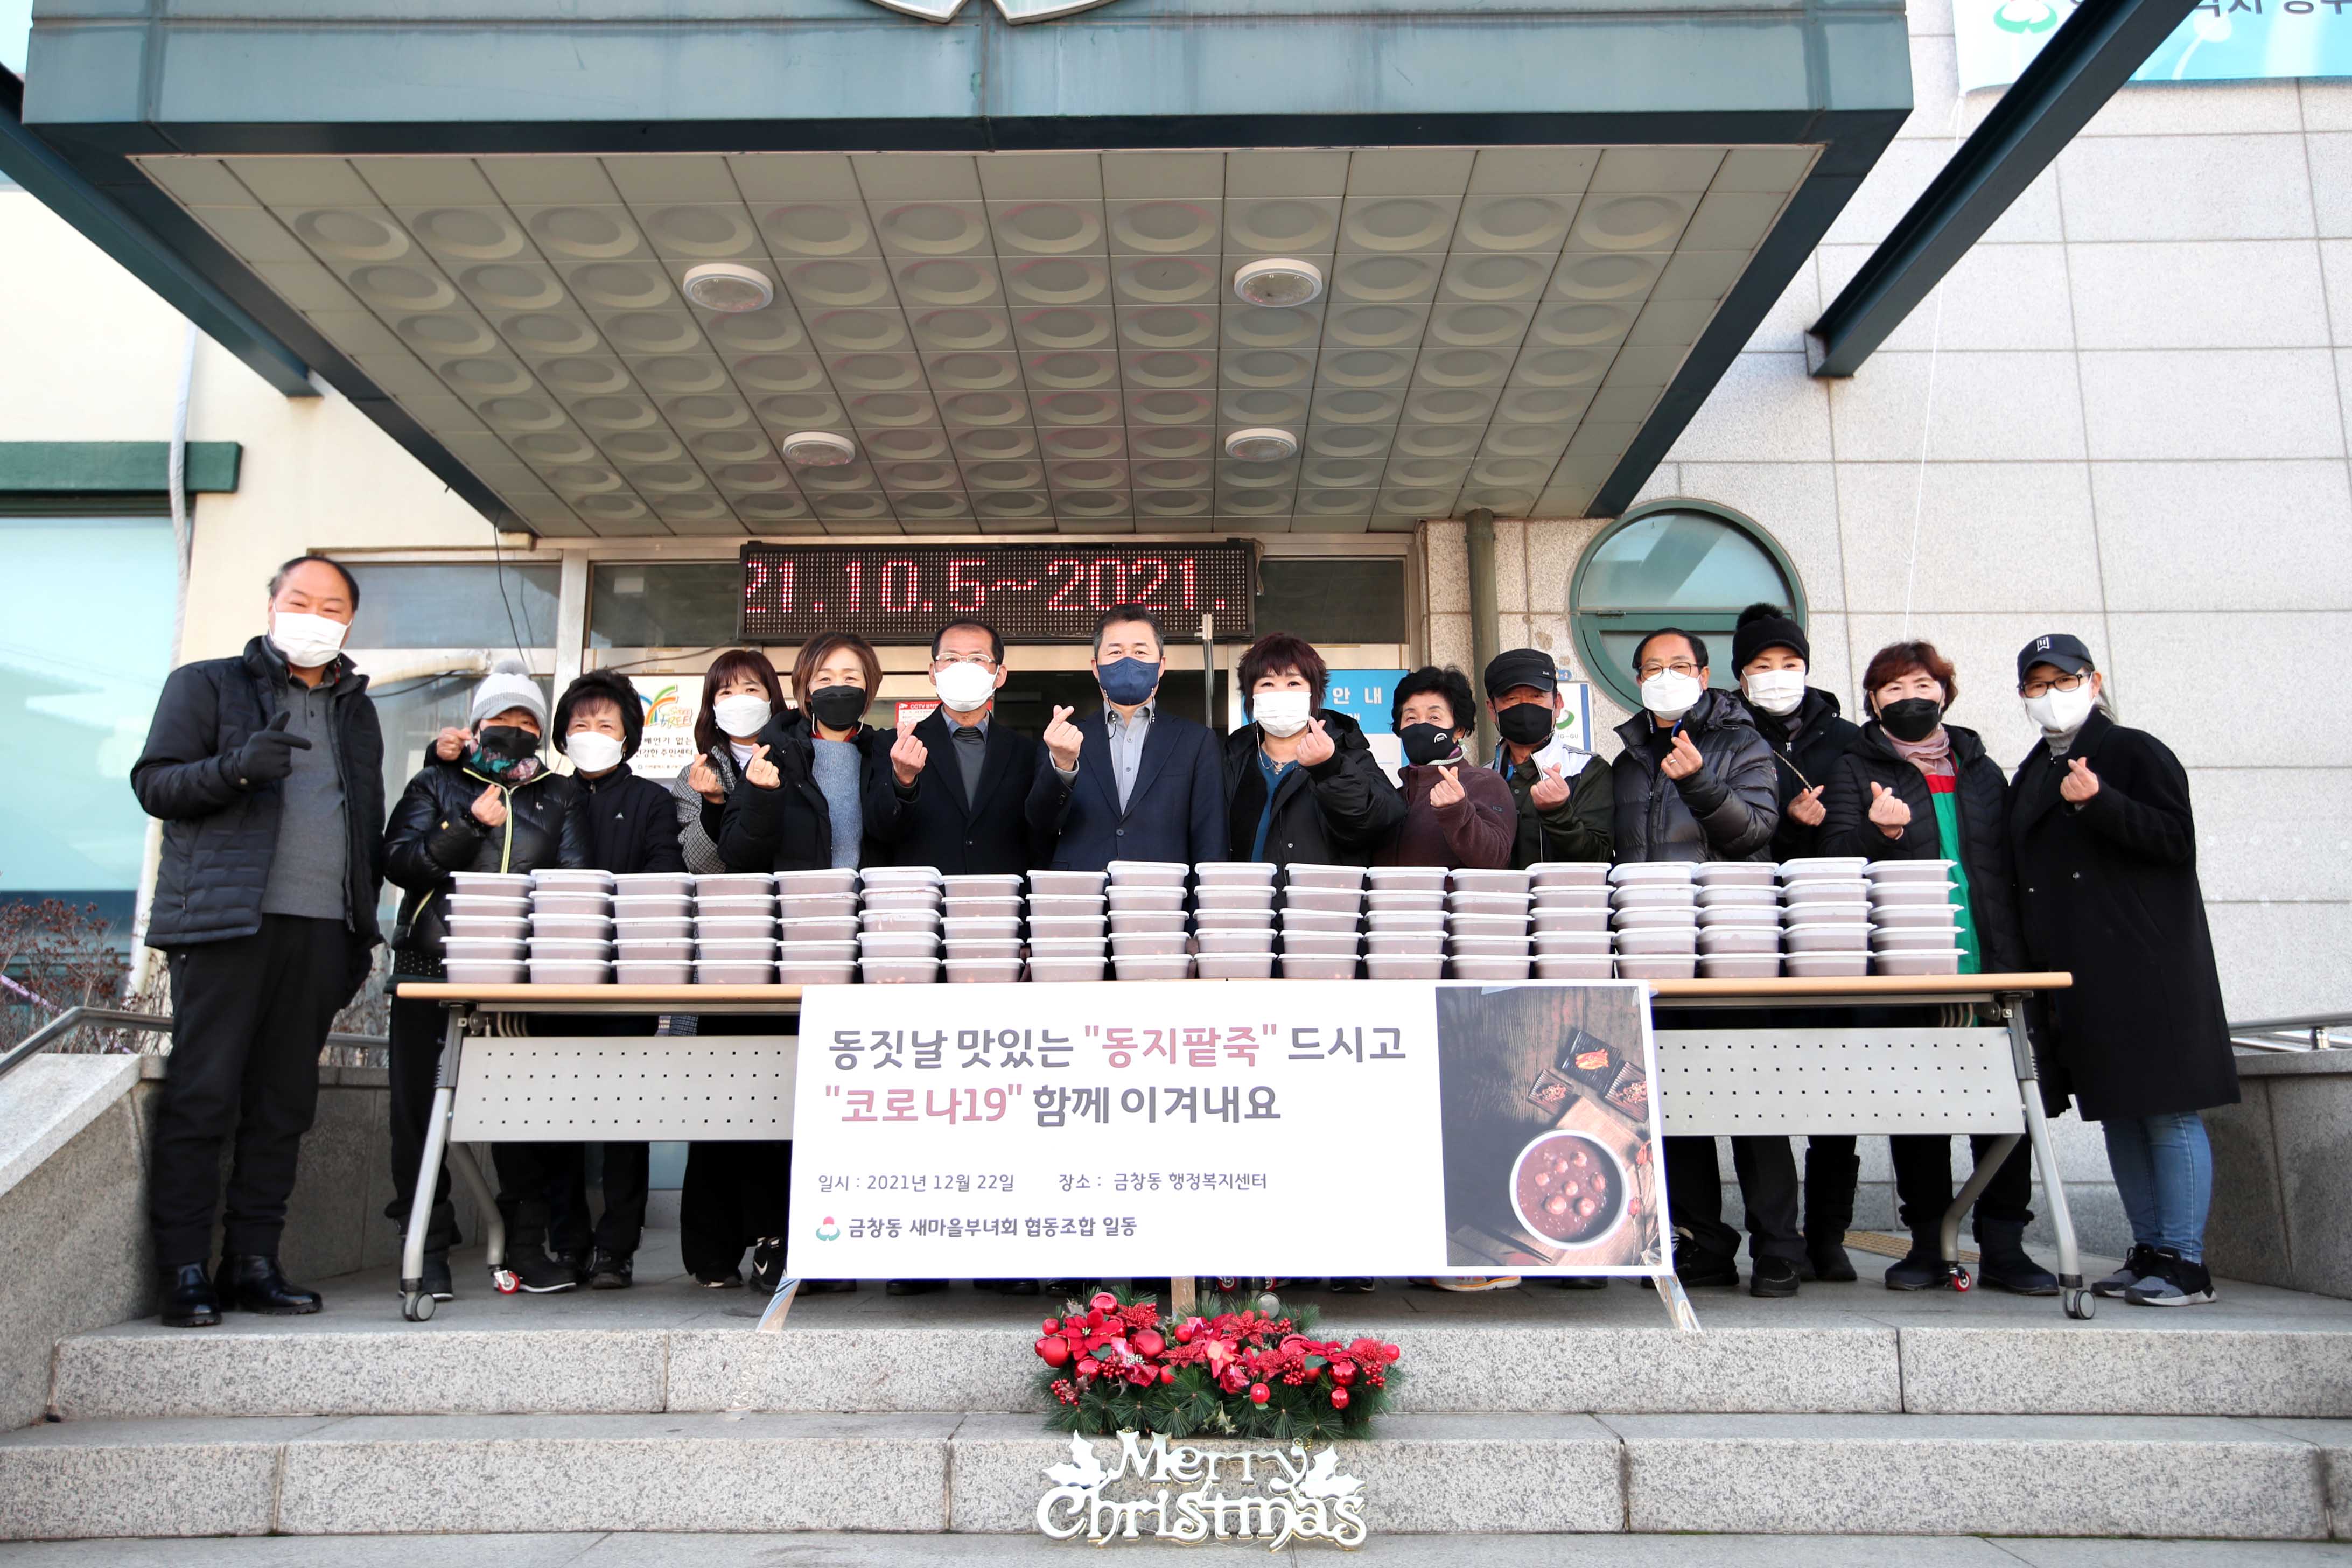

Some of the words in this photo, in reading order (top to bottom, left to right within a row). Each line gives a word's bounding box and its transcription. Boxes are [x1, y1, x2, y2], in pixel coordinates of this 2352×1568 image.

[644, 737, 670, 746] 배연기
[676, 737, 692, 746] 없는
[661, 748, 693, 758] 주민센터
[829, 1030, 948, 1070] 동짓날
[958, 1029, 1074, 1068] 맛있는
[1085, 1024, 1276, 1068] "동지팥죽"
[1288, 1027, 1406, 1063] 드시고
[826, 1084, 1022, 1125] "코로나19"
[1033, 1084, 1109, 1127] 함께
[1121, 1086, 1281, 1123] 이겨내요
[867, 1175, 926, 1192] 2021년
[934, 1174, 969, 1192] 12월
[978, 1174, 1013, 1192] 22일
[1114, 1172, 1162, 1191] 금창동
[1169, 1172, 1266, 1191] 행정복지센터
[849, 1217, 902, 1238] 금창동
[909, 1217, 1017, 1237] 새마을부녀회
[1025, 1216, 1096, 1237] 협동조합
[1103, 1217, 1137, 1236] 일동
[1105, 1430, 1309, 1494] Merry
[1036, 1480, 1368, 1552] Christmas
